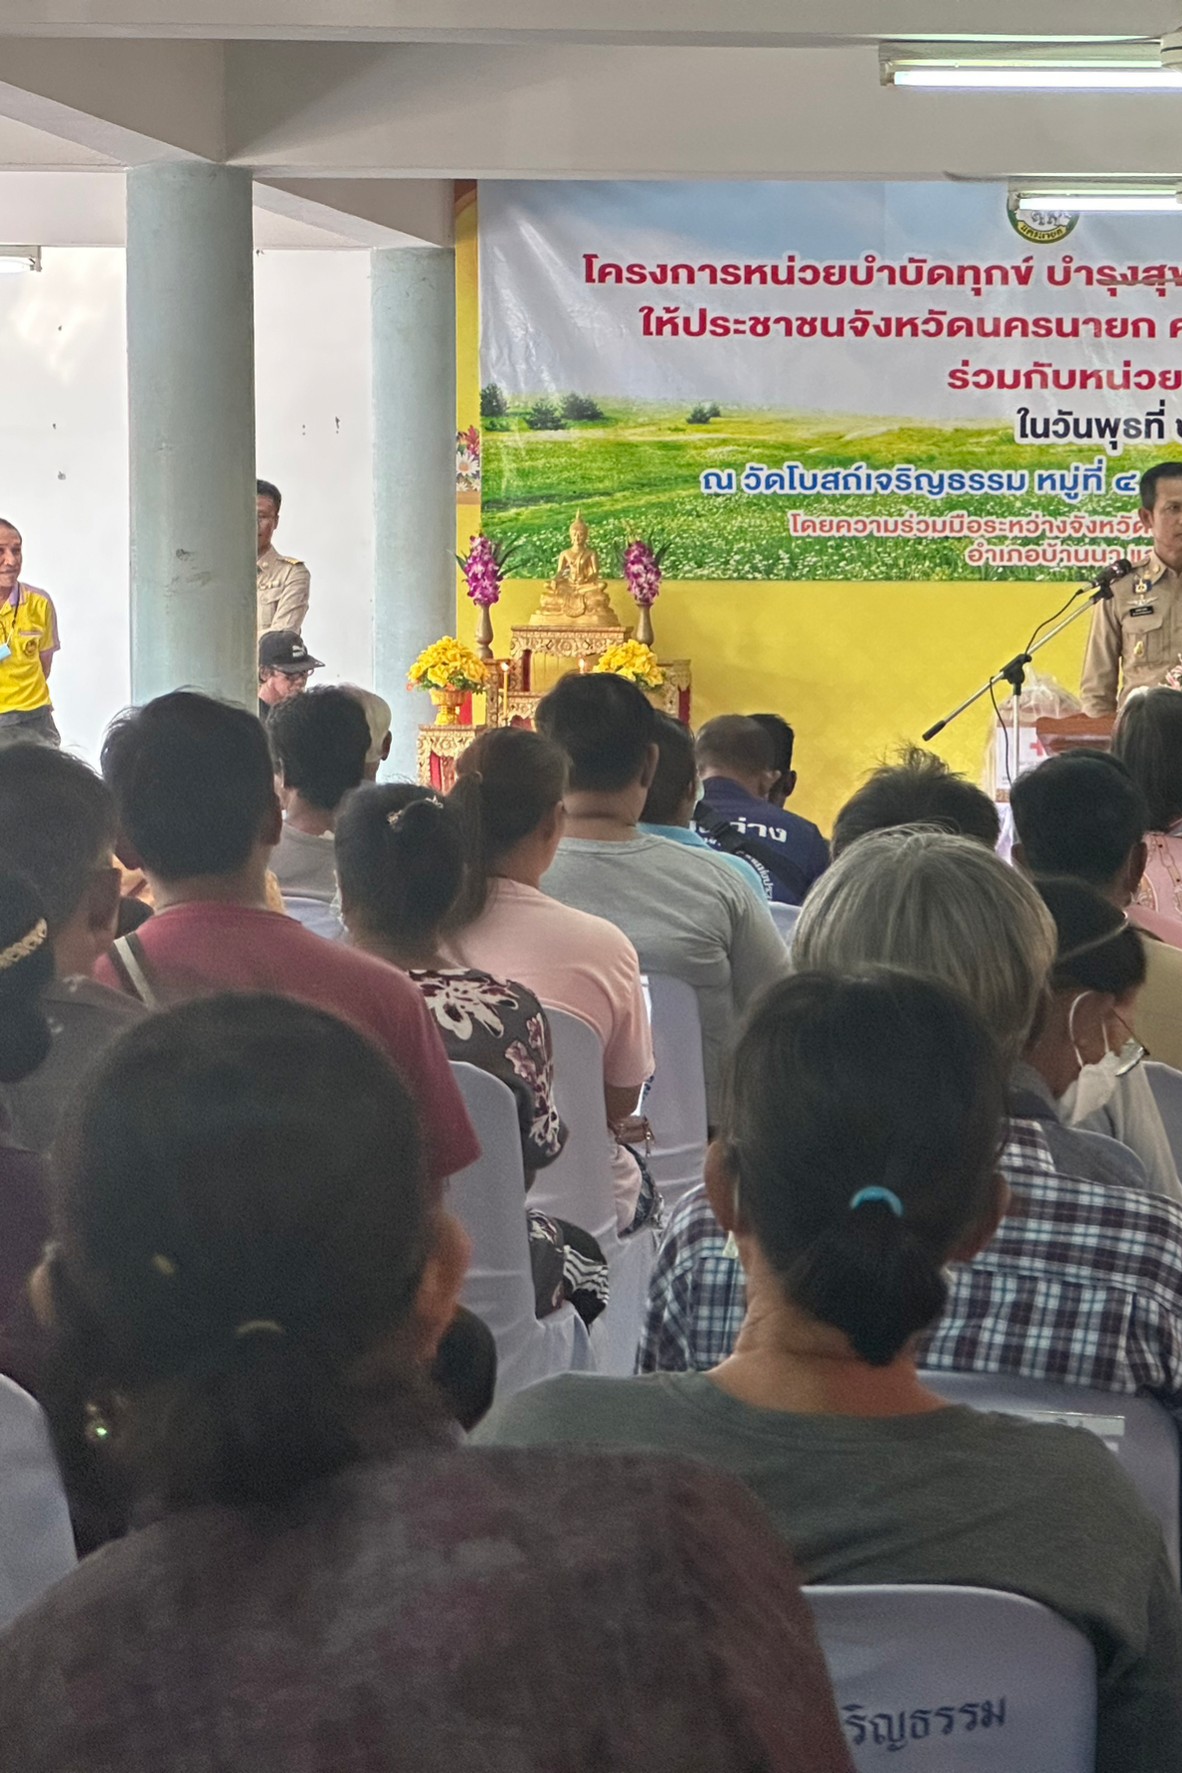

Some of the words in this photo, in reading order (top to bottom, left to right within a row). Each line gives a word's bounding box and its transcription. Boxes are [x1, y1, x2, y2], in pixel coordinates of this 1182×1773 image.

[583, 253, 1034, 297] โครงการหน่วยบำบัดทุกข์
[639, 305, 1157, 339] ให้ประชาชนจังหวัดนครนายก
[1017, 399, 1165, 450] ในวันพุธที่
[702, 472, 733, 493] ณ
[744, 464, 1026, 496] วัดโบสถ์เจริญธรรม
[1037, 459, 1103, 499] หมู่ที่
[1115, 475, 1136, 492] ๔
[967, 543, 1120, 564] อำเภอบ้านนา
[842, 1697, 1006, 1752] ริญธรรม
